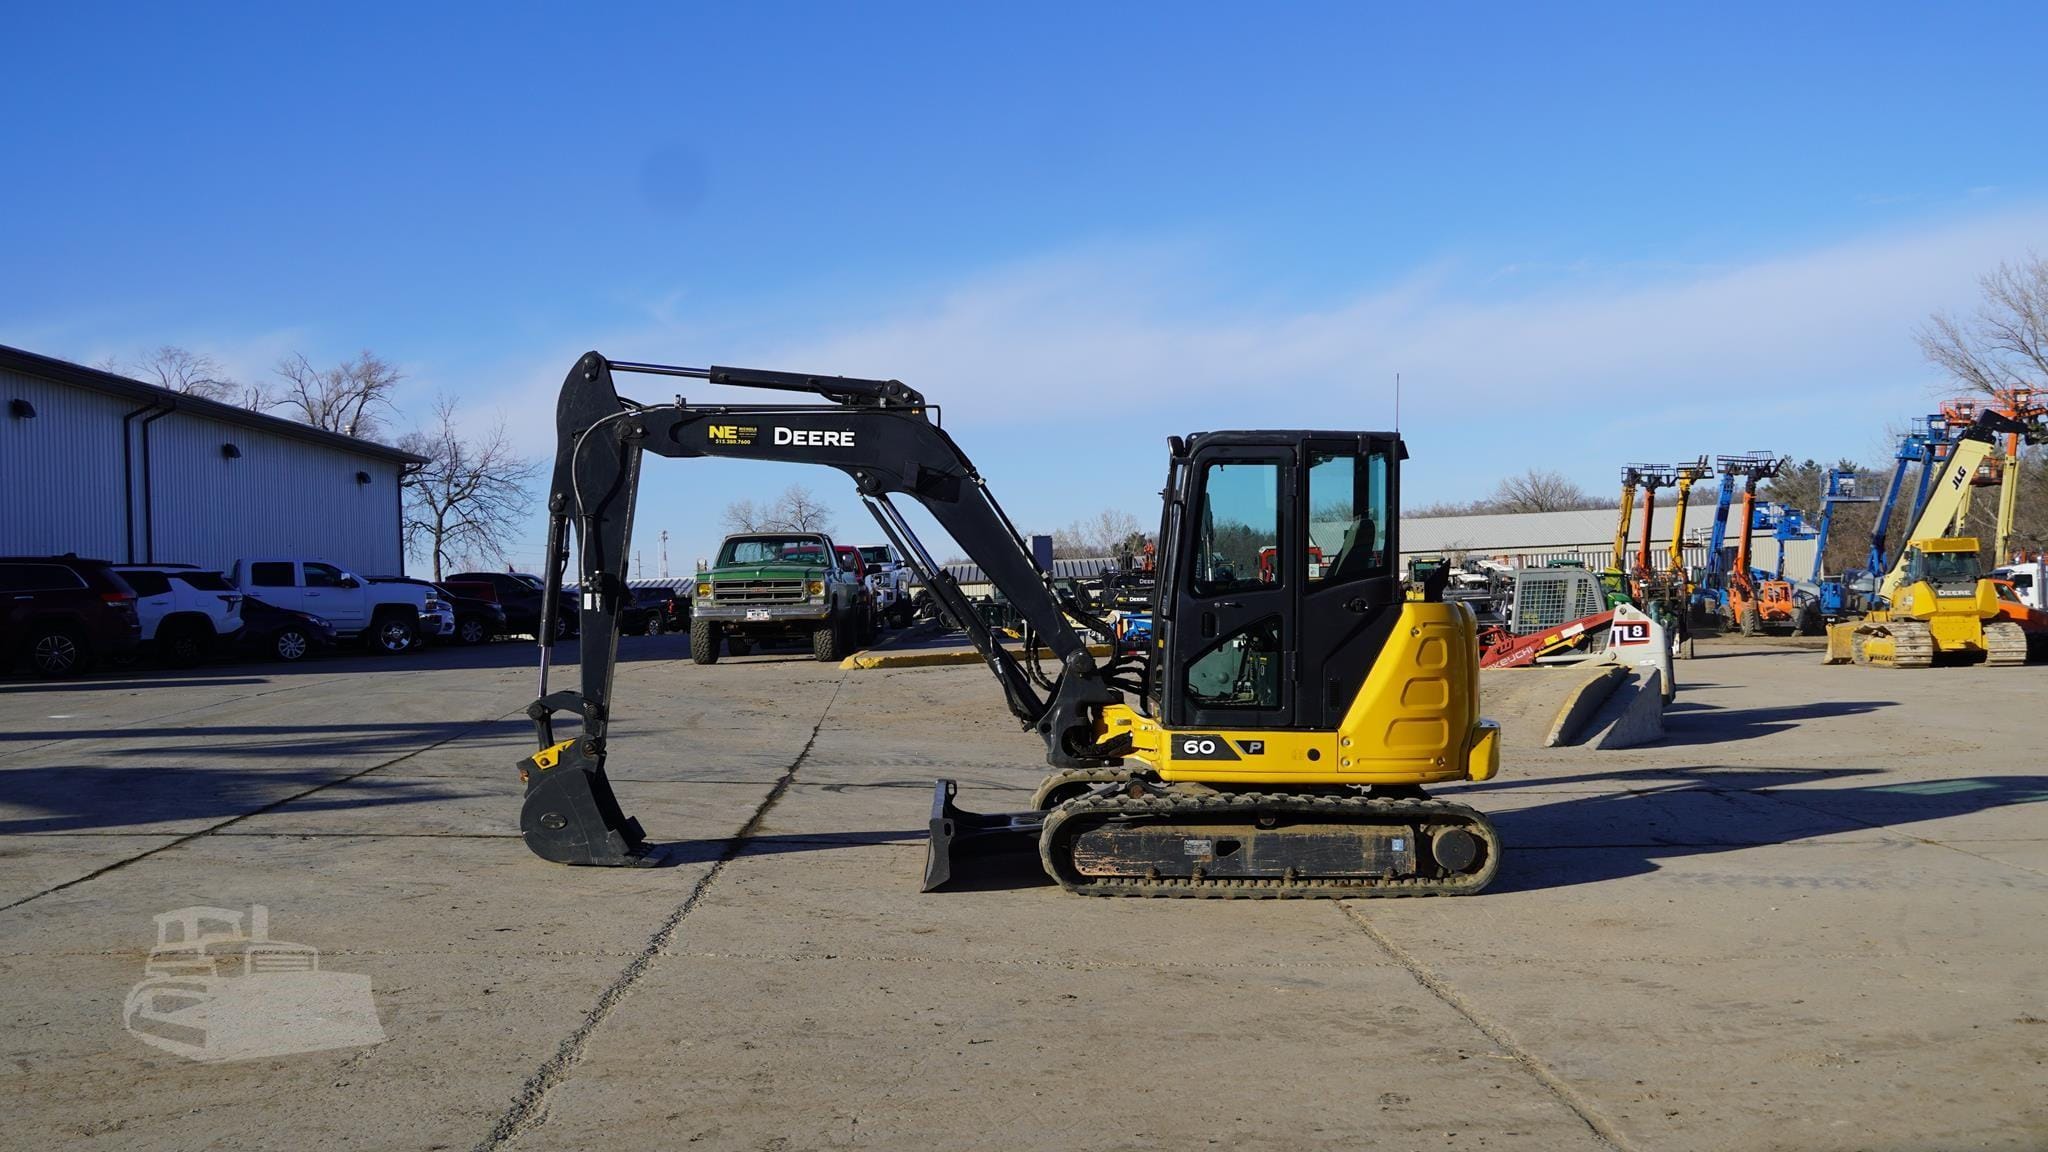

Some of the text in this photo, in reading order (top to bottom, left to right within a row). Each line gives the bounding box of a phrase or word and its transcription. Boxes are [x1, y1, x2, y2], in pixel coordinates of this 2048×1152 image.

[709, 425, 737, 439] NE
[774, 427, 855, 447] DEERE
[1952, 465, 1967, 491] JLG
[1183, 740, 1216, 755] 60
[1249, 742, 1262, 753] P
